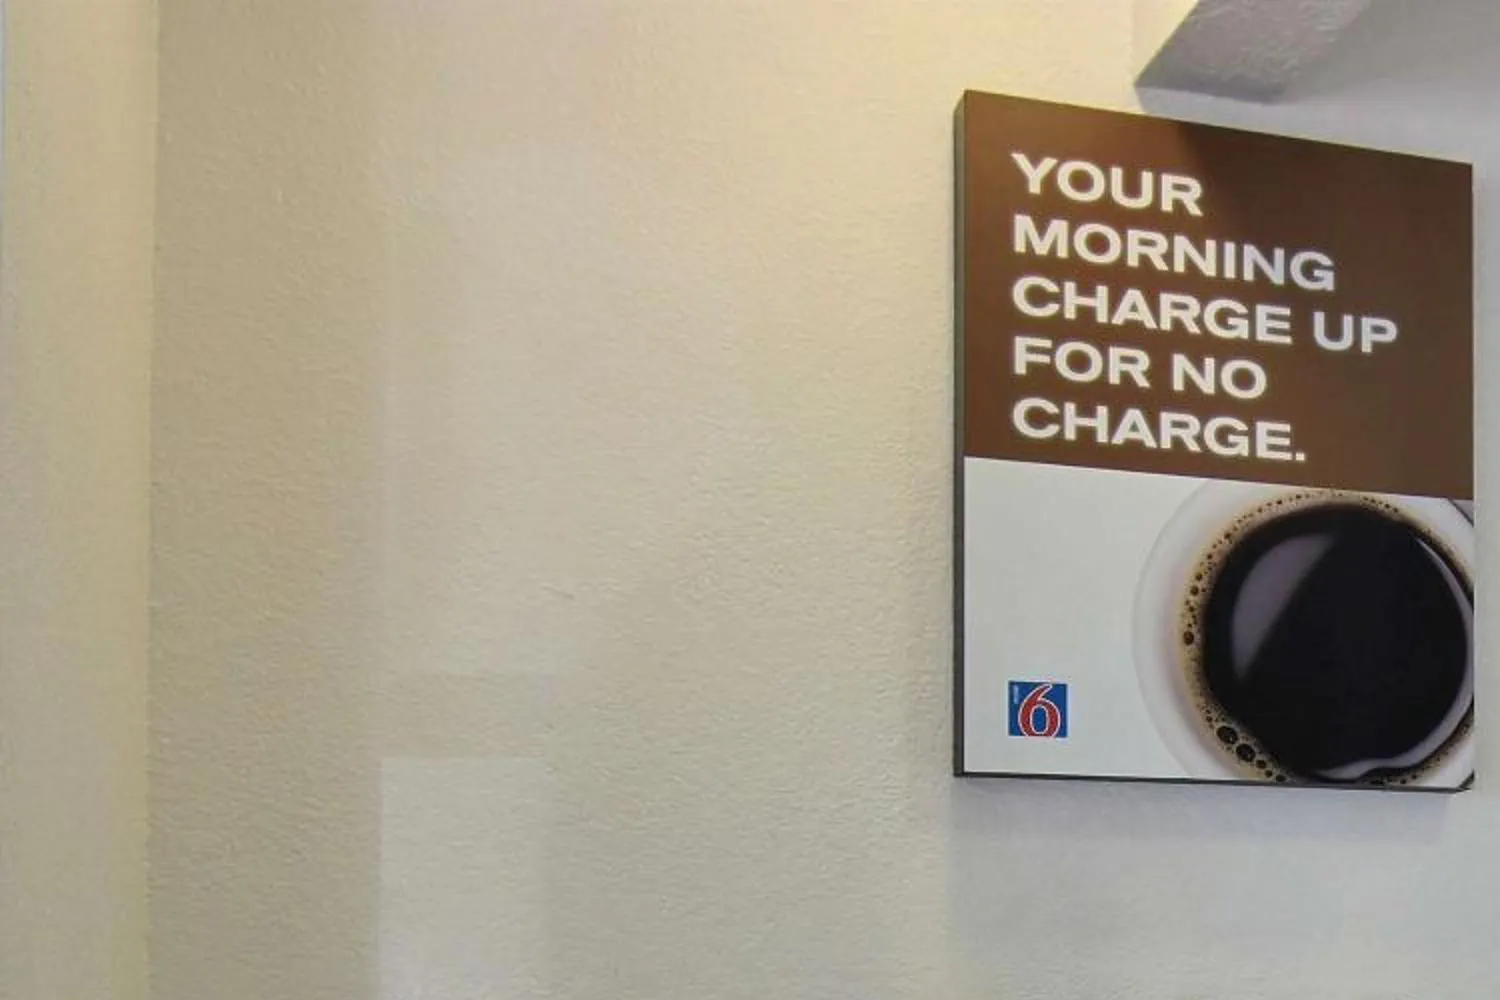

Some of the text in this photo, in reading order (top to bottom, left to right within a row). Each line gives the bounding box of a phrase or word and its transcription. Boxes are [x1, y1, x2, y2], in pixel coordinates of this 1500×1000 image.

[1011, 152, 1204, 217] YOUR
[1012, 213, 1336, 292] MORNING
[1011, 275, 1399, 354] CHARGE UP
[1012, 335, 1268, 400] FOR NO
[1011, 397, 1306, 462] CHARGE.
[1018, 683, 1061, 739] 6
